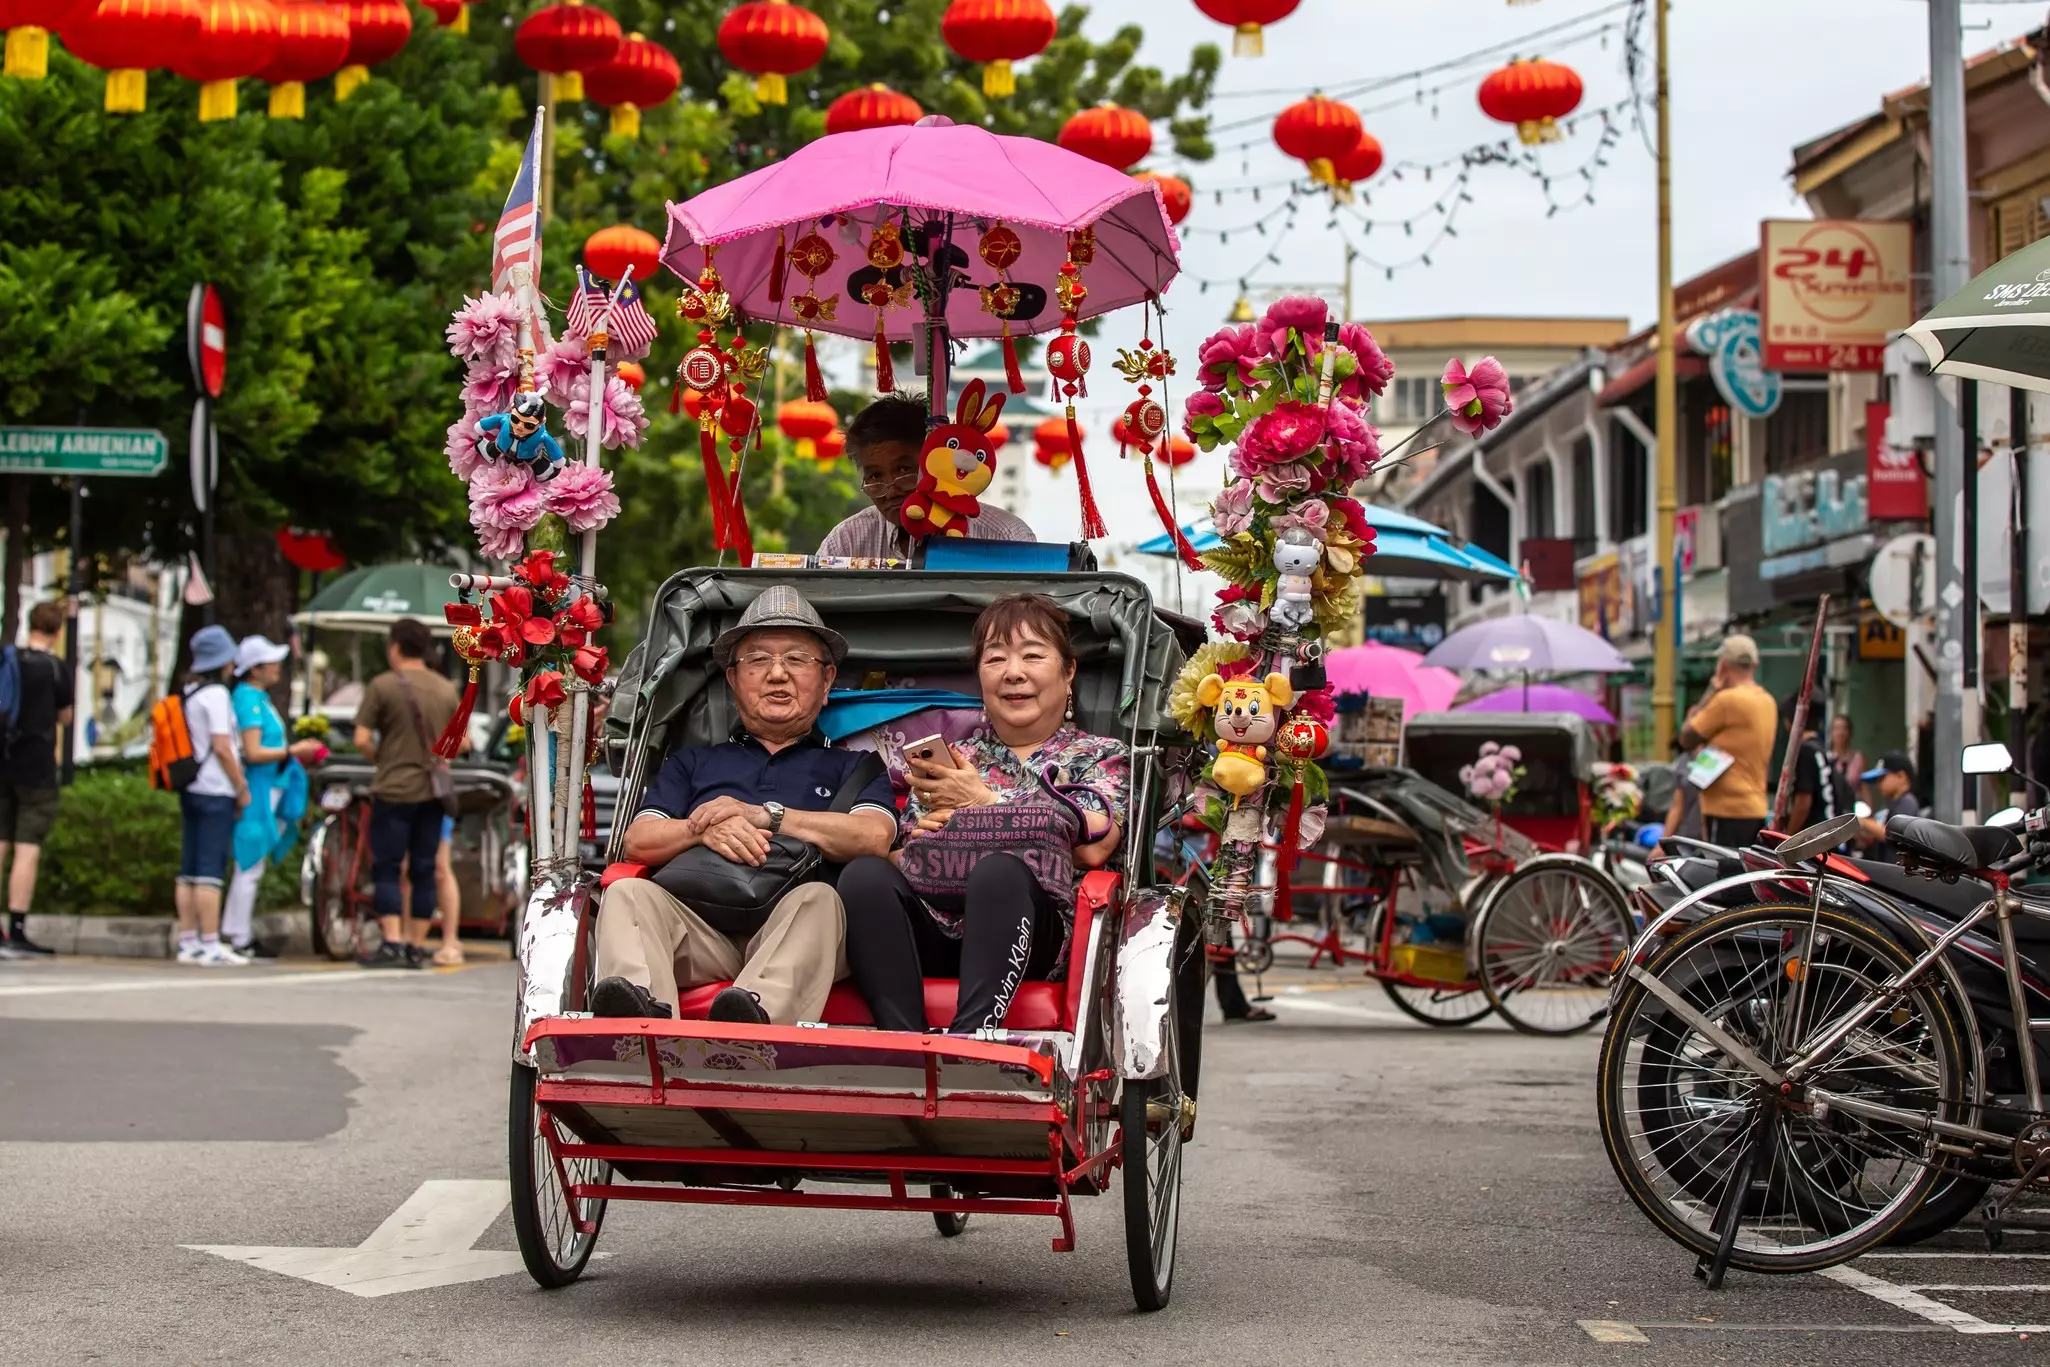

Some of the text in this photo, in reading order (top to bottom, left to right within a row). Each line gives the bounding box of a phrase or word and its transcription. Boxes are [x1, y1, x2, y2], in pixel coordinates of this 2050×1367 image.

[1774, 248, 1876, 279] 24
[1983, 284, 2031, 299] SMS
[1828, 345, 1860, 368] 24
[691, 361, 709, 378] 福
[60, 434, 157, 455] ARMENIAN
[961, 831, 993, 840] SWISS
[995, 831, 1027, 840] SWISS
[983, 917, 1031, 1029] Calvin Klein
